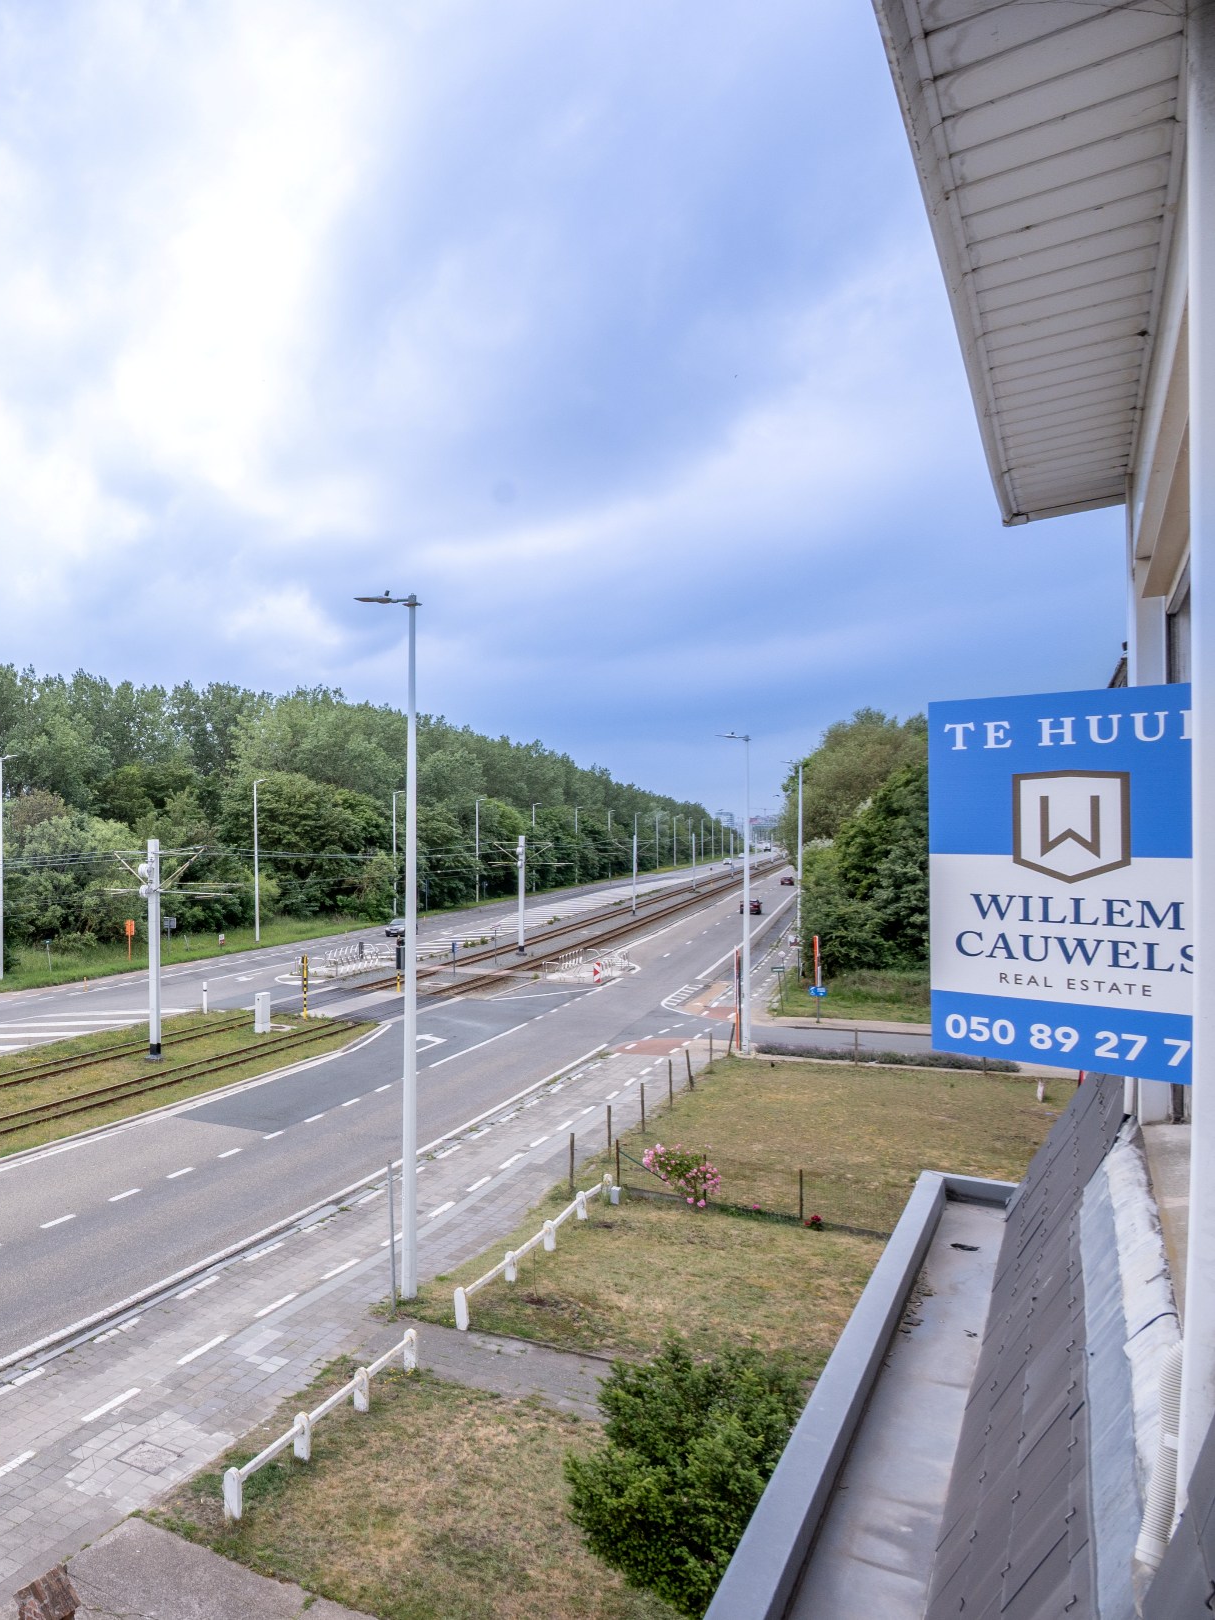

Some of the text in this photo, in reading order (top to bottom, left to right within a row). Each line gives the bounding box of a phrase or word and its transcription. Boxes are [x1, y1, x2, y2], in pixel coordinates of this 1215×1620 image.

[944, 721, 1012, 750] TE
[970, 893, 1185, 930] WILLEM
[955, 930, 1193, 974] CAUWELS
[999, 972, 1152, 997] REAL ESTATE
[945, 1013, 1016, 1045] 050
[1029, 1023, 1080, 1053] 89
[1094, 1030, 1148, 1061] 27
